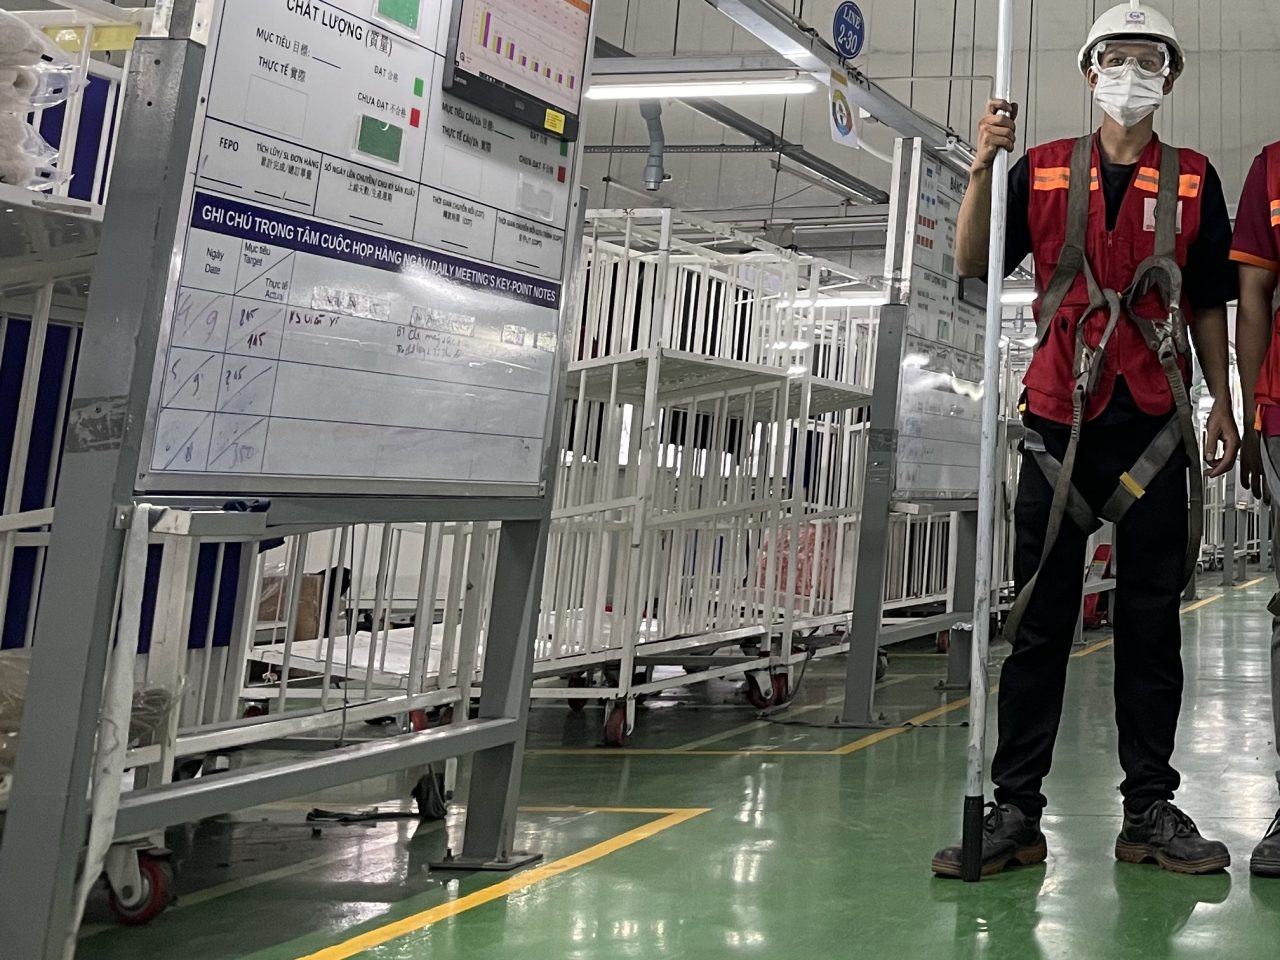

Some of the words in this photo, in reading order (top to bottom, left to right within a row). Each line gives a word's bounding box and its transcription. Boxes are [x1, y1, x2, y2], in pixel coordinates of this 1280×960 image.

[842, 6, 861, 30] LINE
[256, 27, 274, 43] MỤC
[275, 34, 291, 50] TIÊU
[321, 10, 363, 41] LƯỢNG
[365, 29, 393, 58] (質量)
[837, 24, 858, 53] 2-30
[258, 55, 279, 73] THỰC
[280, 62, 290, 76] TẾ
[357, 92, 375, 106] CHƯA
[376, 98, 389, 111] ĐẠT
[441, 102, 454, 115] MỤC
[219, 137, 239, 152] FEPO
[257, 142, 269, 153] TÍCH
[303, 157, 320, 169] HÀNG
[202, 204, 224, 224] GHI
[226, 211, 252, 230] CHÚ
[254, 217, 294, 240] TRỌNG
[296, 225, 320, 246] TÂM
[320, 233, 351, 254] CUỘC
[352, 241, 374, 259] HỌP
[374, 244, 402, 264] HÀNG
[431, 259, 455, 277] DAILY
[455, 267, 496, 288] MEETING'S
[496, 276, 533, 295] KEY-POINT
[533, 286, 557, 302] NOTES
[206, 247, 224, 261] Ngày
[244, 242, 259, 256] Mục
[204, 263, 221, 275] Date
[243, 253, 263, 268] Target
[265, 277, 281, 291] Thực
[264, 289, 285, 301] Actual
